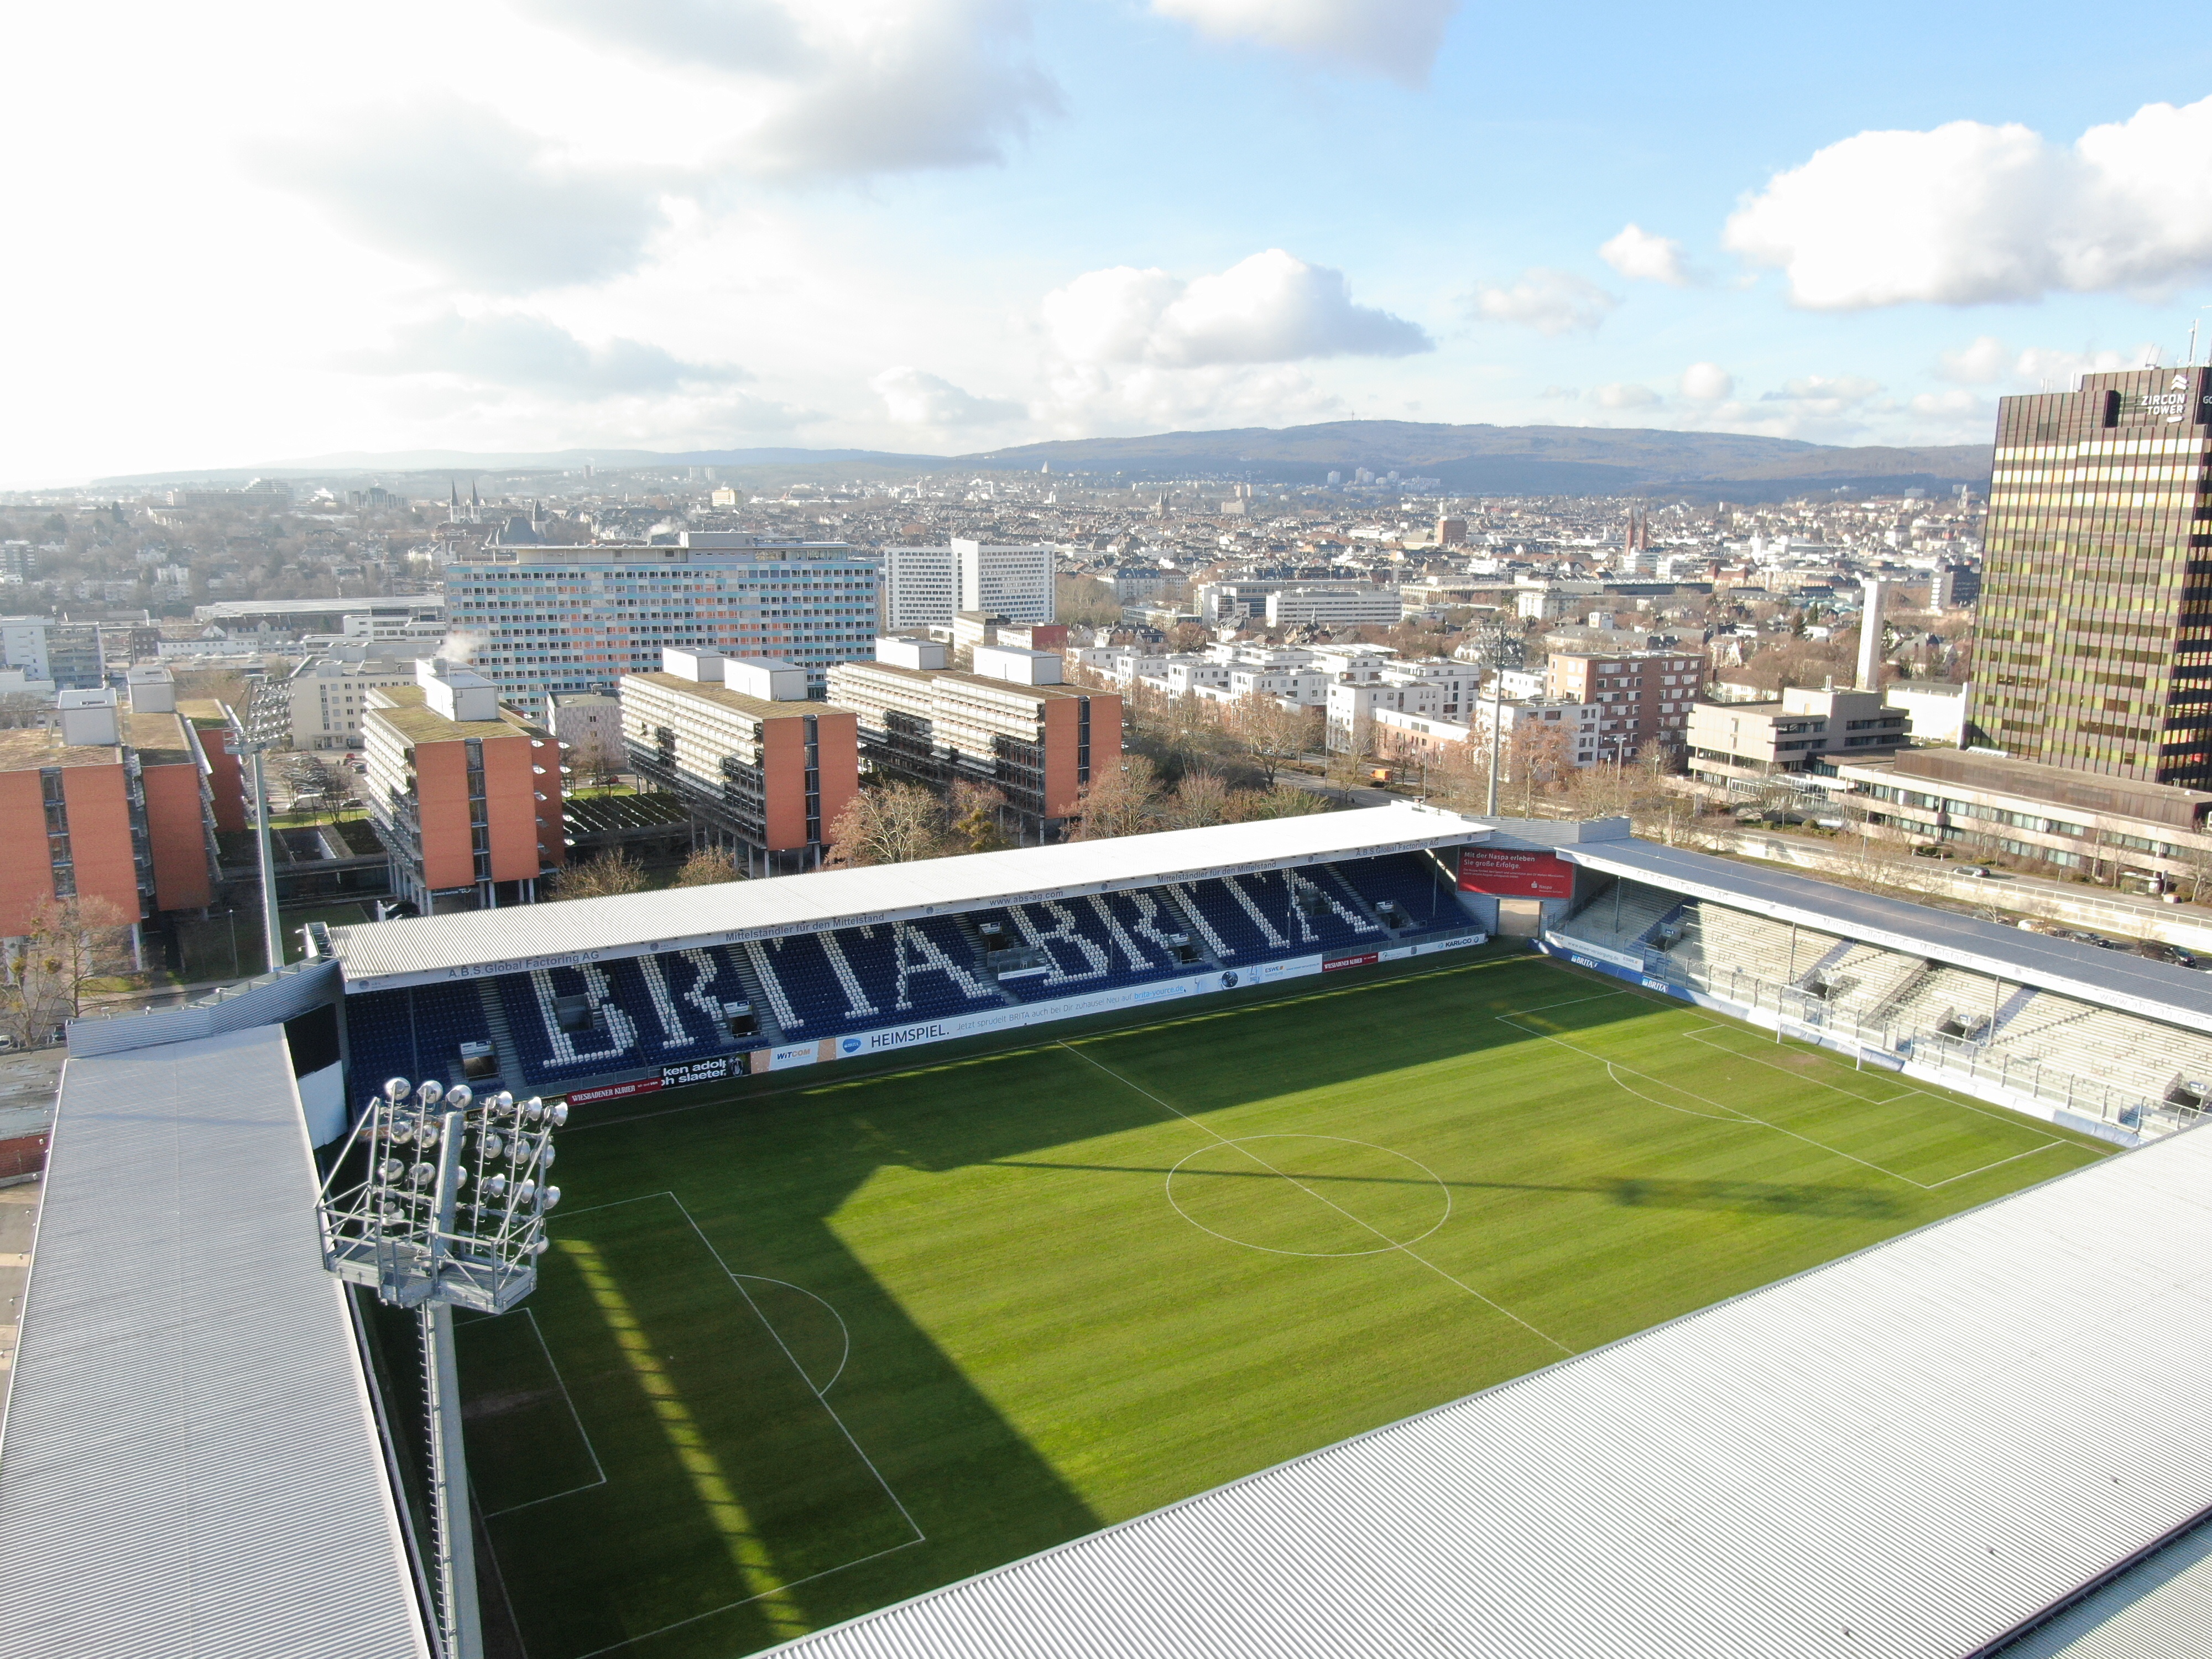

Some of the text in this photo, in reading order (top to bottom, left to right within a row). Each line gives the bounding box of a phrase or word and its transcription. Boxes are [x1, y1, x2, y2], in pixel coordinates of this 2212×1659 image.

[2141, 393, 2185, 406] ZIRCON
[2147, 405, 2184, 415] TOWER
[1376, 844, 1397, 854] Global
[1398, 841, 1428, 851] Factoring
[1157, 861, 1277, 884] Mittelständler für den Mittelstand
[1495, 862, 1521, 870] Erfolge.
[989, 890, 1064, 907] www.abs-ag.com
[726, 913, 885, 941] Mittelständler für den Mittelstand
[448, 951, 599, 978] A.B.S. Global Factoring AG
[1575, 957, 1593, 968] BRITA
[1647, 980, 1667, 993] BRITA
[957, 1020, 976, 1031] Jetzt
[977, 1015, 1007, 1028] sprudelt
[1009, 1011, 1030, 1022] BRITA
[1031, 1008, 1048, 1018] auch
[1050, 1005, 1061, 1014] bei
[1063, 1003, 1073, 1013] Dir
[1106, 997, 1120, 1005] Neu
[1134, 984, 1184, 1001] brita-yource.de
[2099, 993, 2204, 1026] wwwabs-ag.com
[871, 1024, 950, 1048] HEIMSPIEL.
[663, 1065, 688, 1077] ken
[678, 1067, 727, 1084] slaeter.
[571, 1089, 613, 1102] WIESBADENER
[614, 1084, 636, 1095] KURIER
